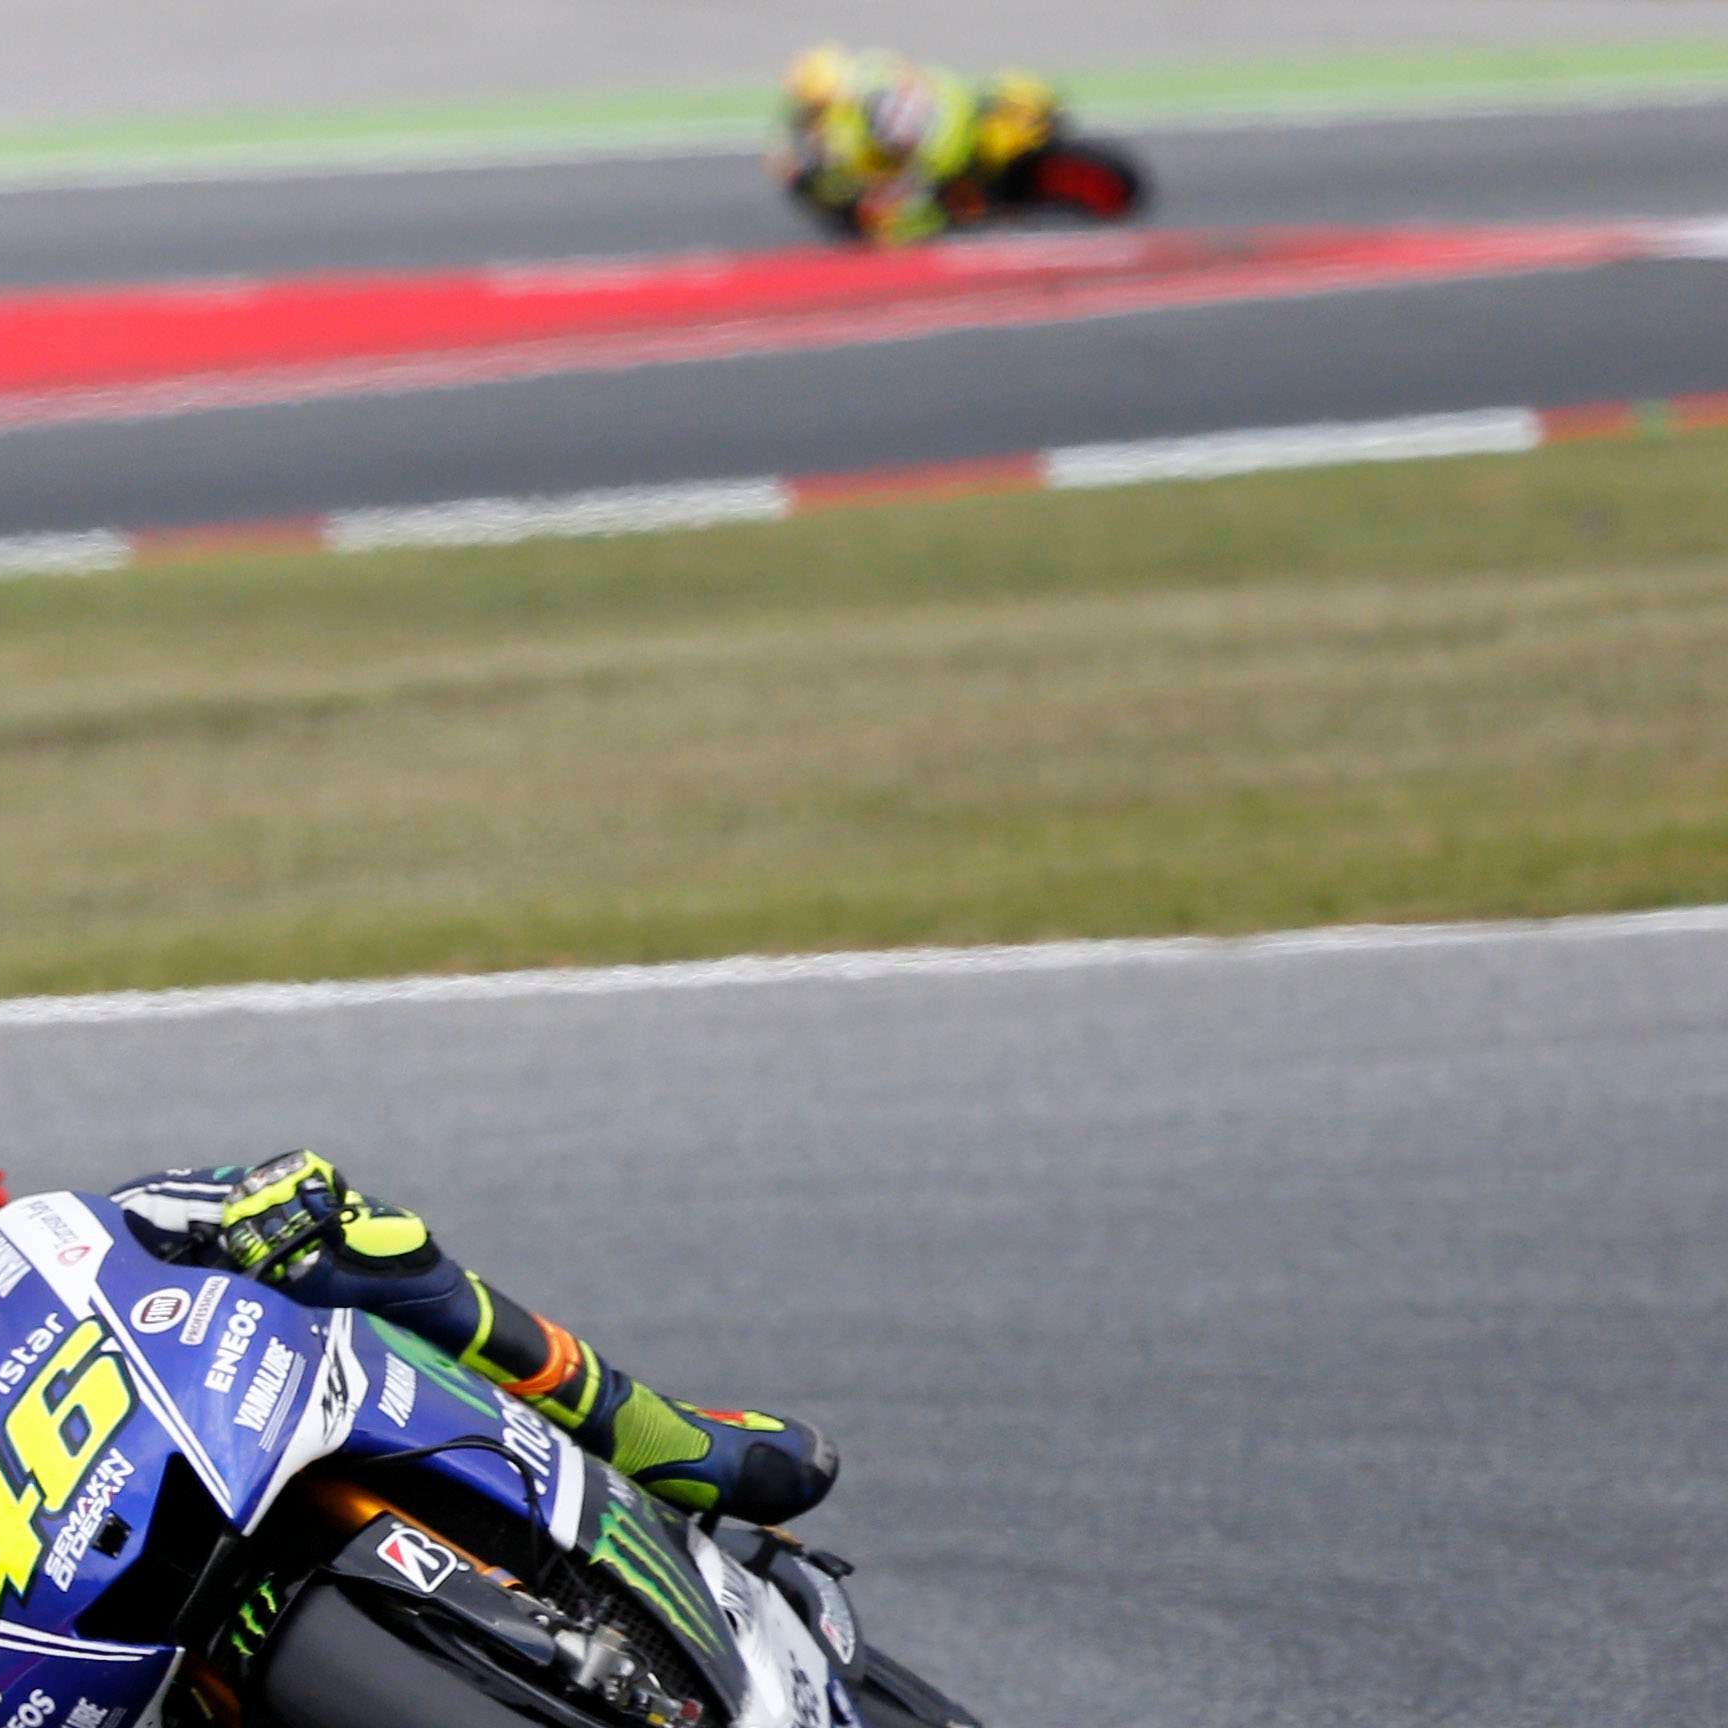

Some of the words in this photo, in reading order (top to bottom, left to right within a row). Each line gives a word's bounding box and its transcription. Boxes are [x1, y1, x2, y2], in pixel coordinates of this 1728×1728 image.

[204, 1299, 264, 1393] ENEOS
[234, 1336, 294, 1432] YAMALUBE
[44, 1448, 125, 1578] SEMAKIN
[69, 1463, 136, 1569] DEPAN
